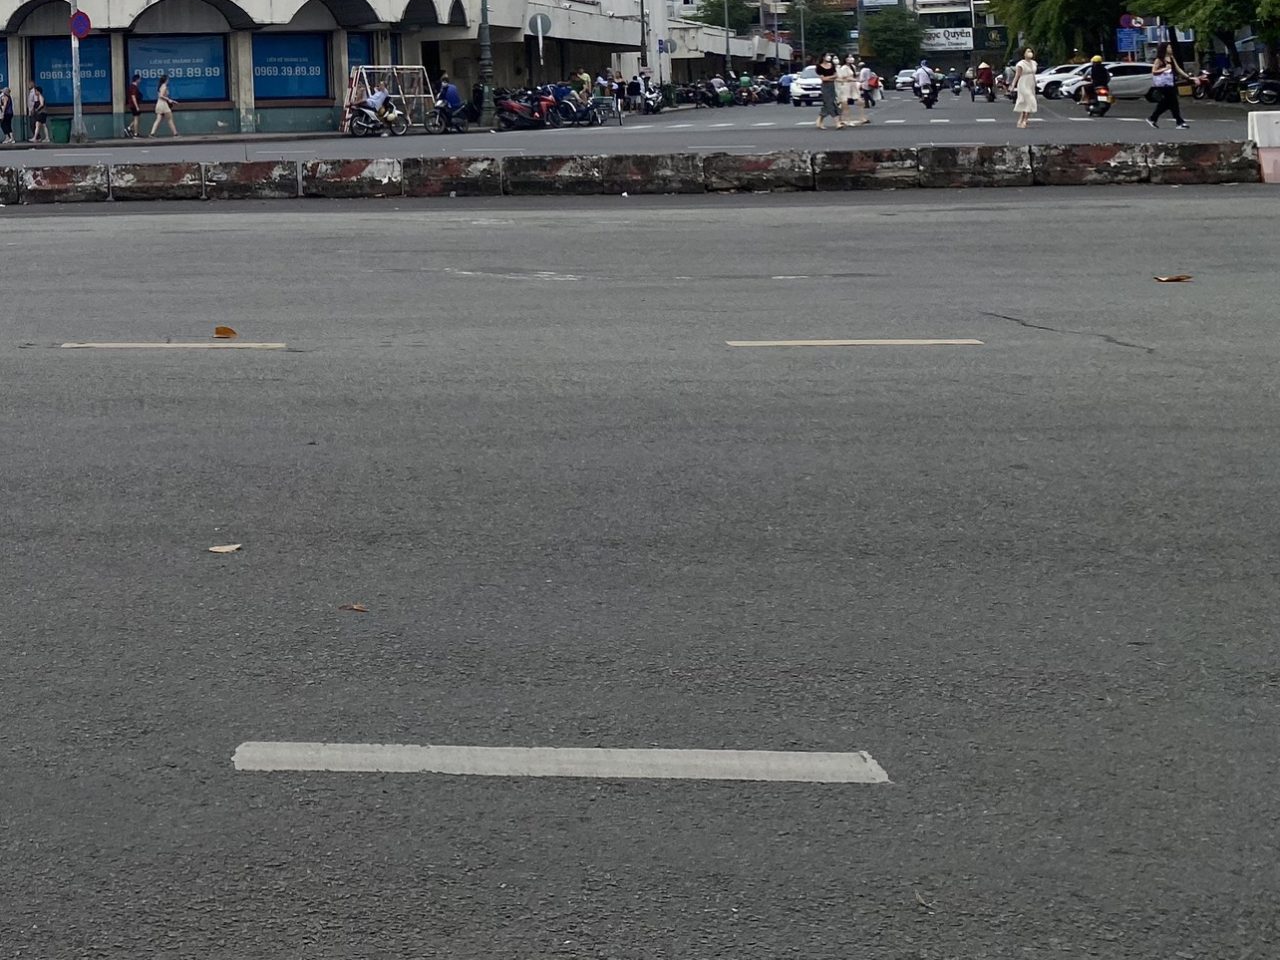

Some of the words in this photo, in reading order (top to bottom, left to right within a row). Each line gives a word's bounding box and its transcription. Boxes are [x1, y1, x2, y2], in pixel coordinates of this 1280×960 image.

[40, 69, 106, 80] 0969.389.89
[134, 66, 220, 78] 096939.89.89
[254, 66, 321, 76] 0969.39.89.89
